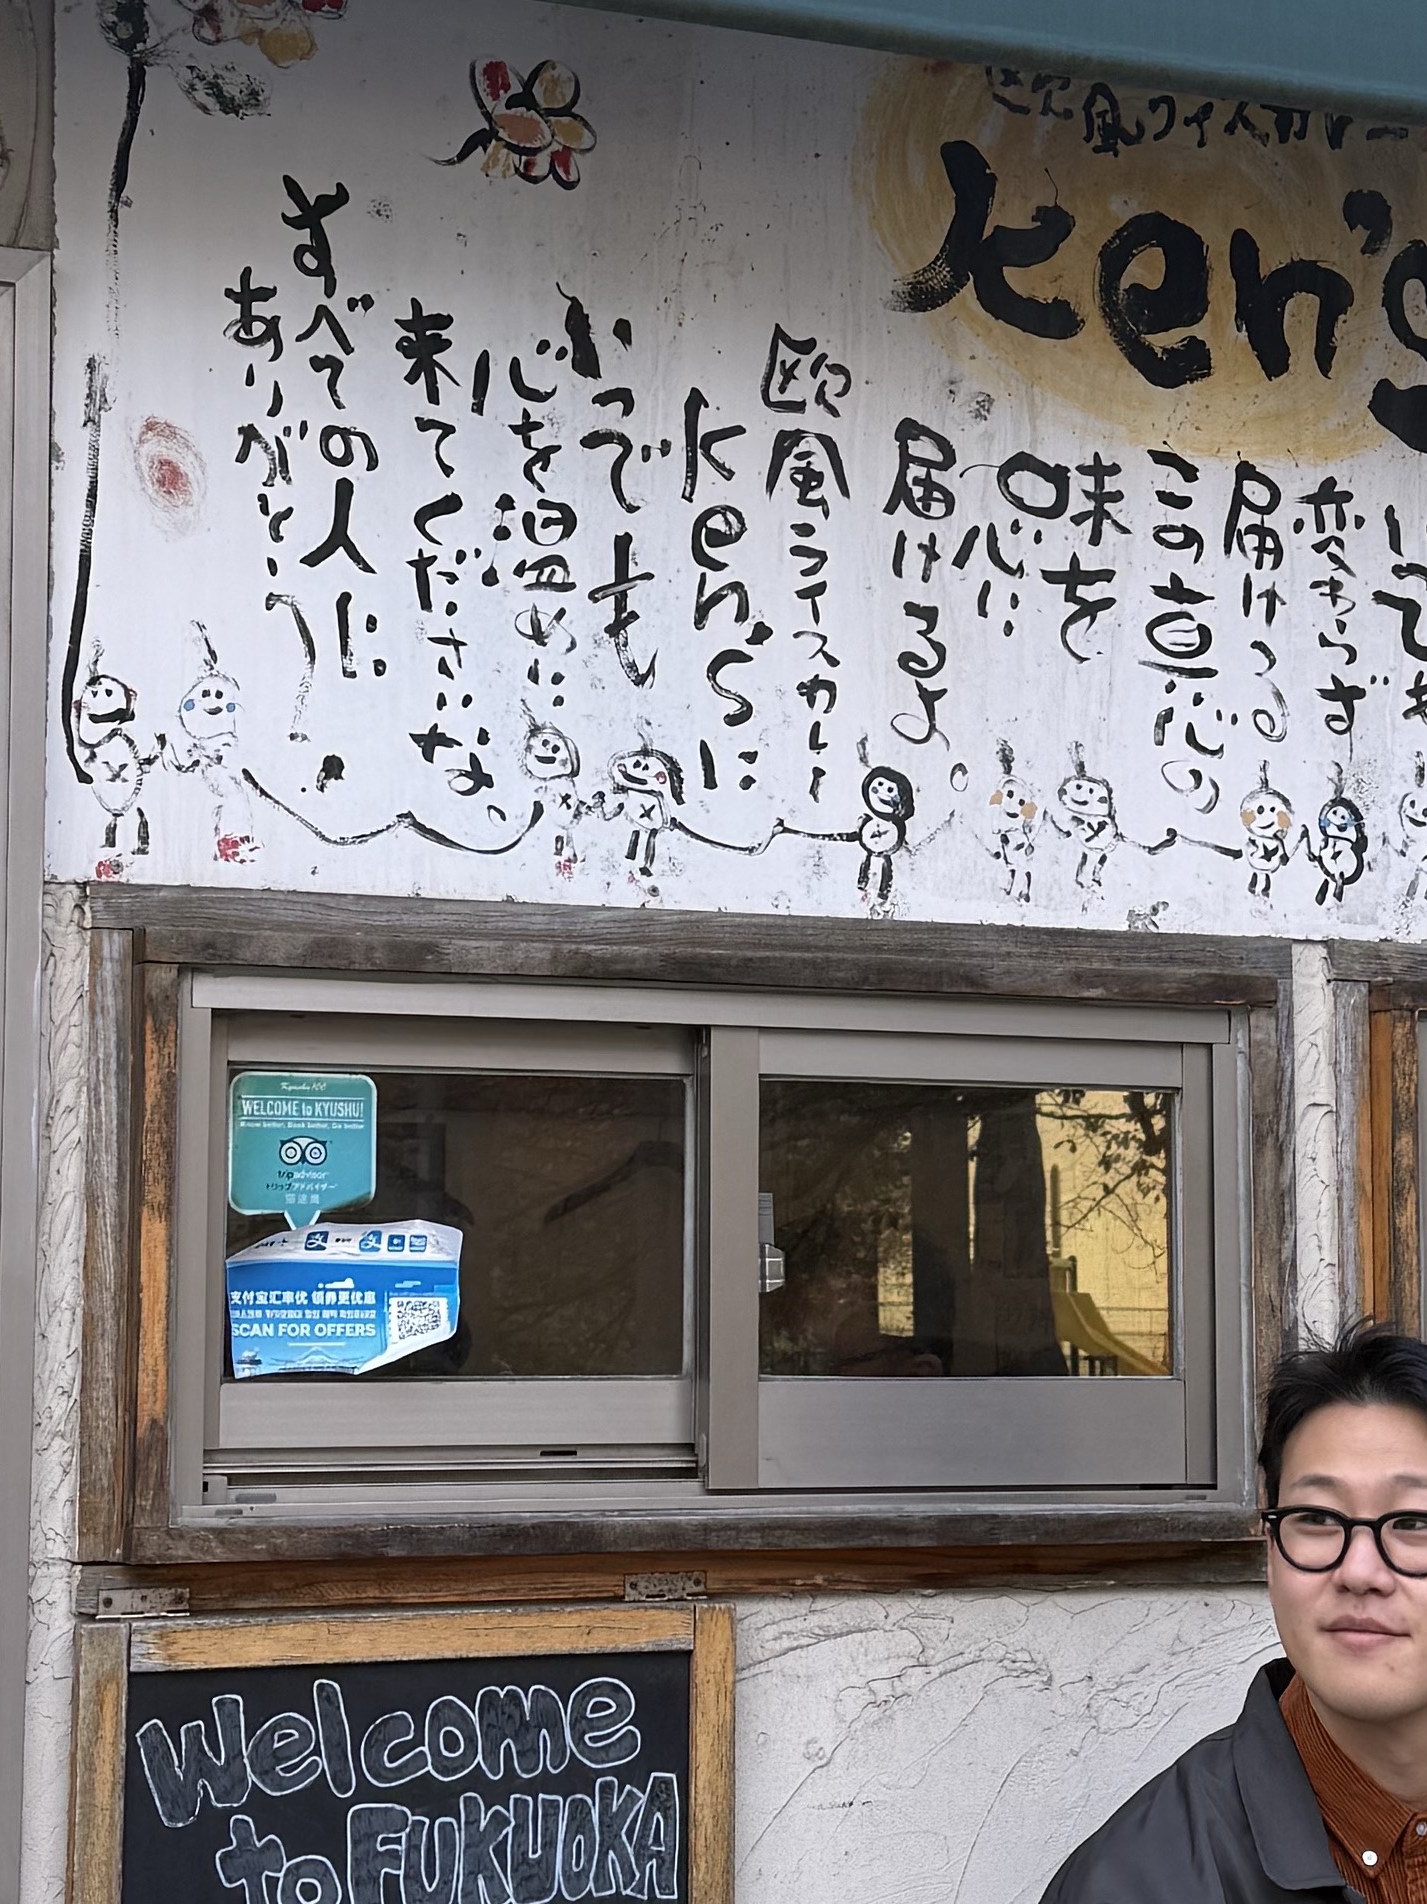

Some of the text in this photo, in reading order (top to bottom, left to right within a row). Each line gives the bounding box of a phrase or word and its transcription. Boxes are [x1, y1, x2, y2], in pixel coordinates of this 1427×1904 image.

[760, 322, 852, 804] 欧風ライスカレー
[241, 1099, 364, 1118] WELCOME to KYUSHU!
[231, 1323, 377, 1337] SCAN FOR OFFERS
[135, 1677, 642, 1828] Welcome
